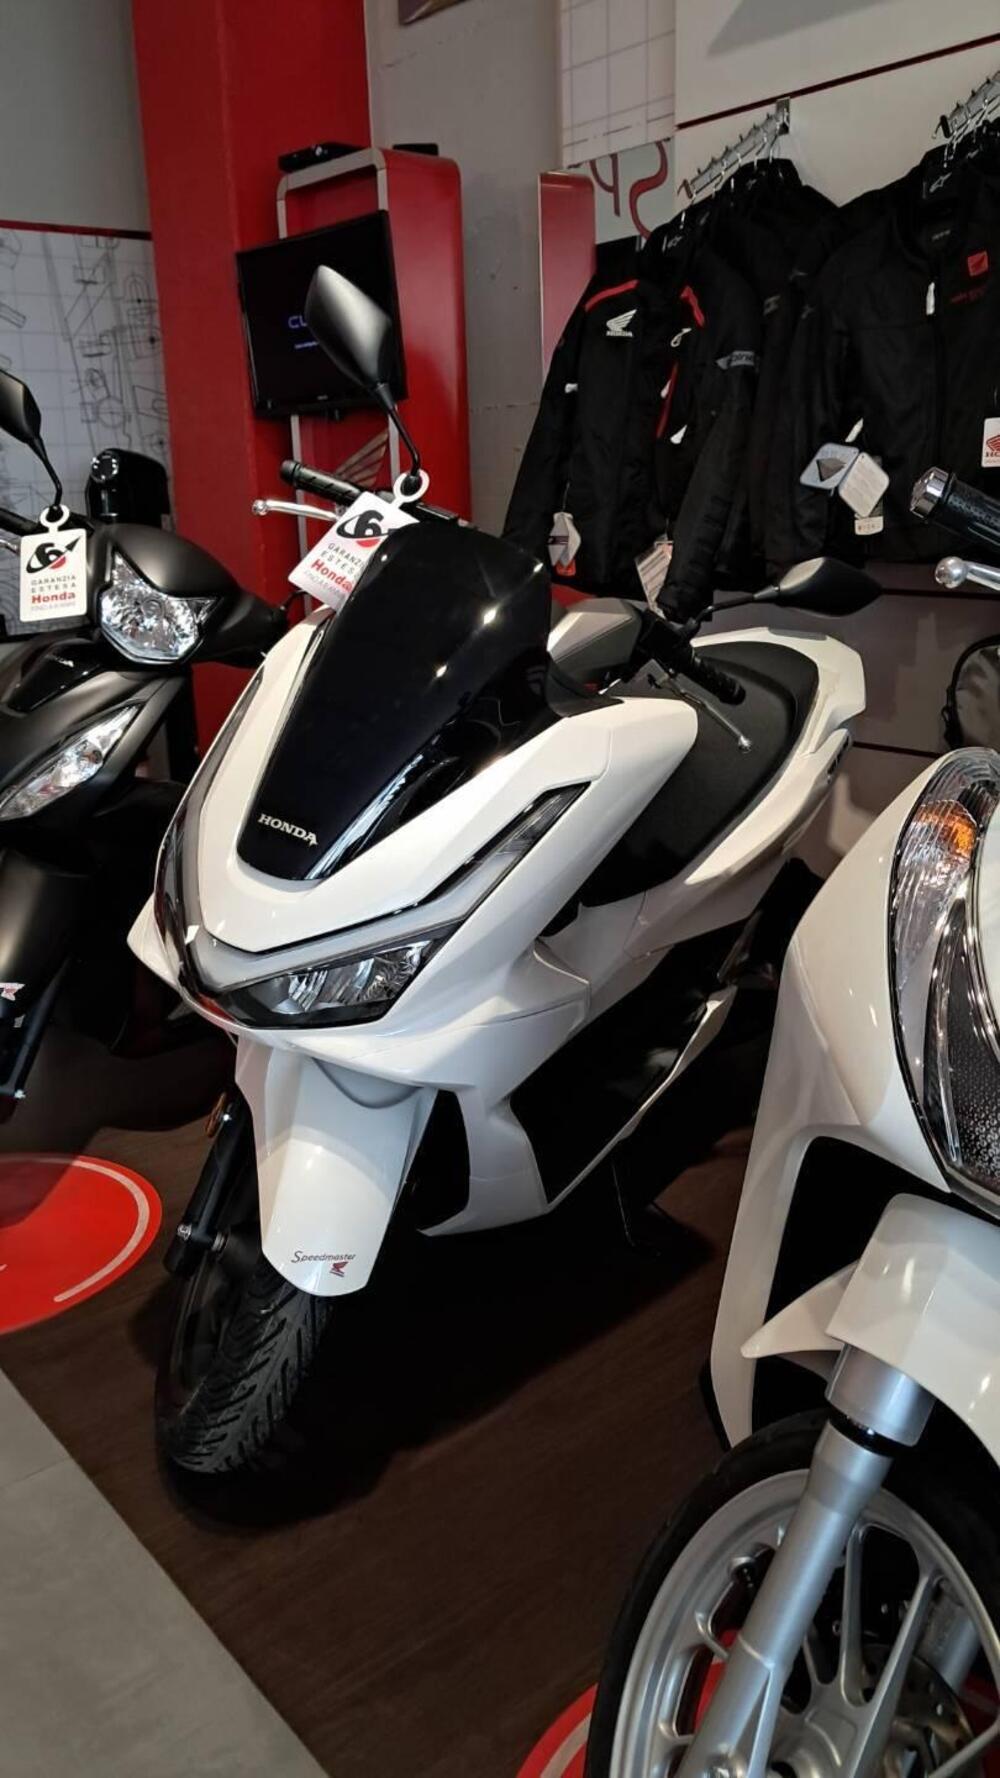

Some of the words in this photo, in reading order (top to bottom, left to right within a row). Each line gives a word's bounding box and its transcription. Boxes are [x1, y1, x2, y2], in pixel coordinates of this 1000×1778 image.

[320, 550, 356, 575] ESTES
[328, 543, 364, 567] GARANZ
[31, 575, 76, 586] GARANZIA
[311, 558, 354, 593] Honda
[31, 591, 76, 604] Honda
[258, 813, 319, 847] HONDA
[291, 1250, 357, 1263] Speedmaster
